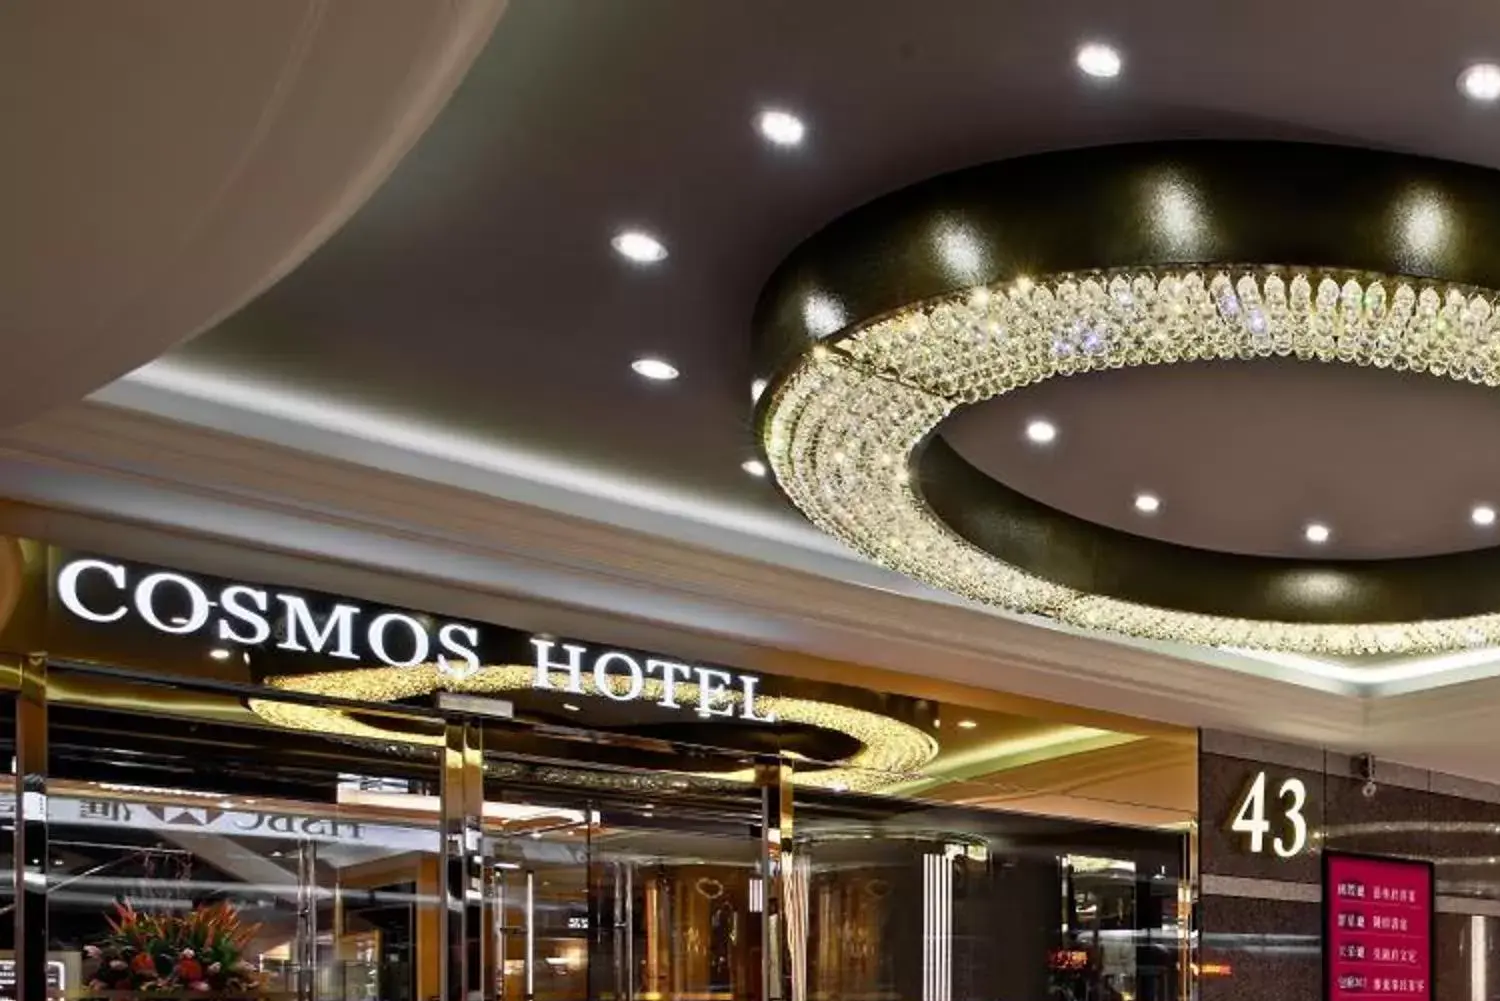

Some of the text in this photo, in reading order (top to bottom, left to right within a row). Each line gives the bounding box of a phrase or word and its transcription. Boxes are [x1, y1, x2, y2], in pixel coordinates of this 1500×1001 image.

[57, 558, 776, 722] COSMOS HOTEL
[1231, 771, 1307, 857] 43
